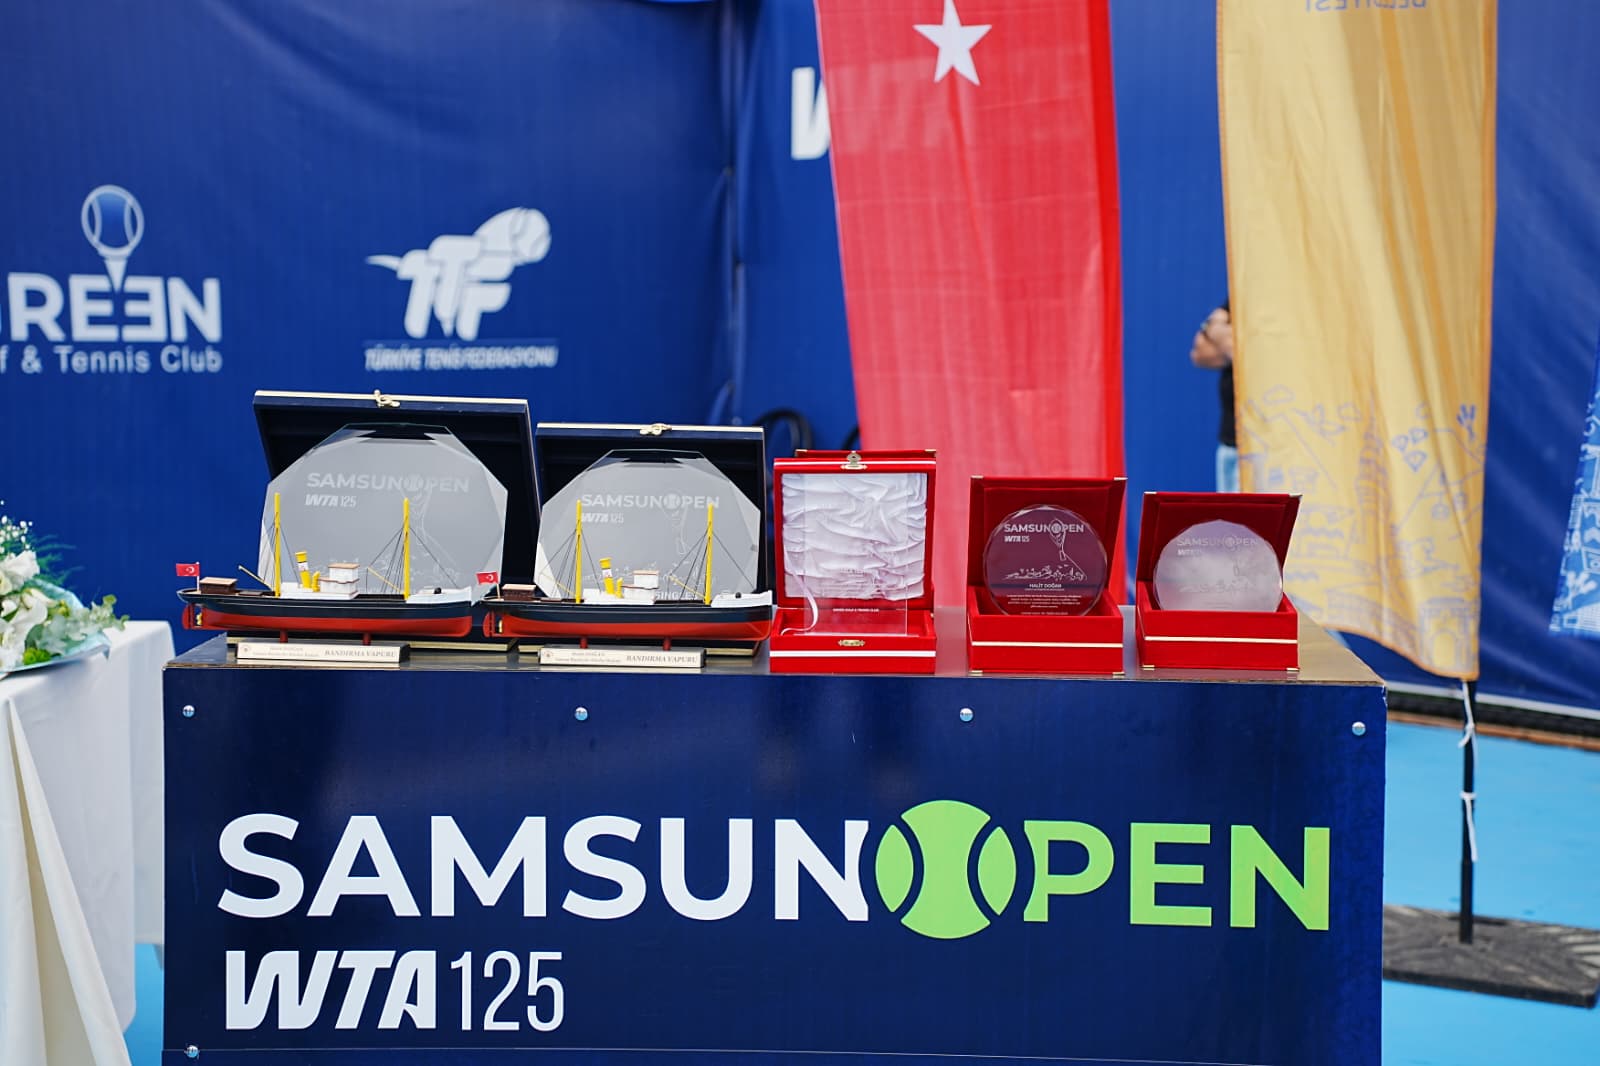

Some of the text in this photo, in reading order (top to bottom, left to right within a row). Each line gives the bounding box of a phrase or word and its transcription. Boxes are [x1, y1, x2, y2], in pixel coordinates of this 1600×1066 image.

[0, 272, 222, 343] REEN
[20, 344, 43, 374] &
[53, 344, 151, 374] Tennis
[160, 344, 223, 374] Club
[305, 493, 357, 508] WTA 125
[580, 512, 609, 524] WTA
[224, 950, 565, 1032] WTA 125
